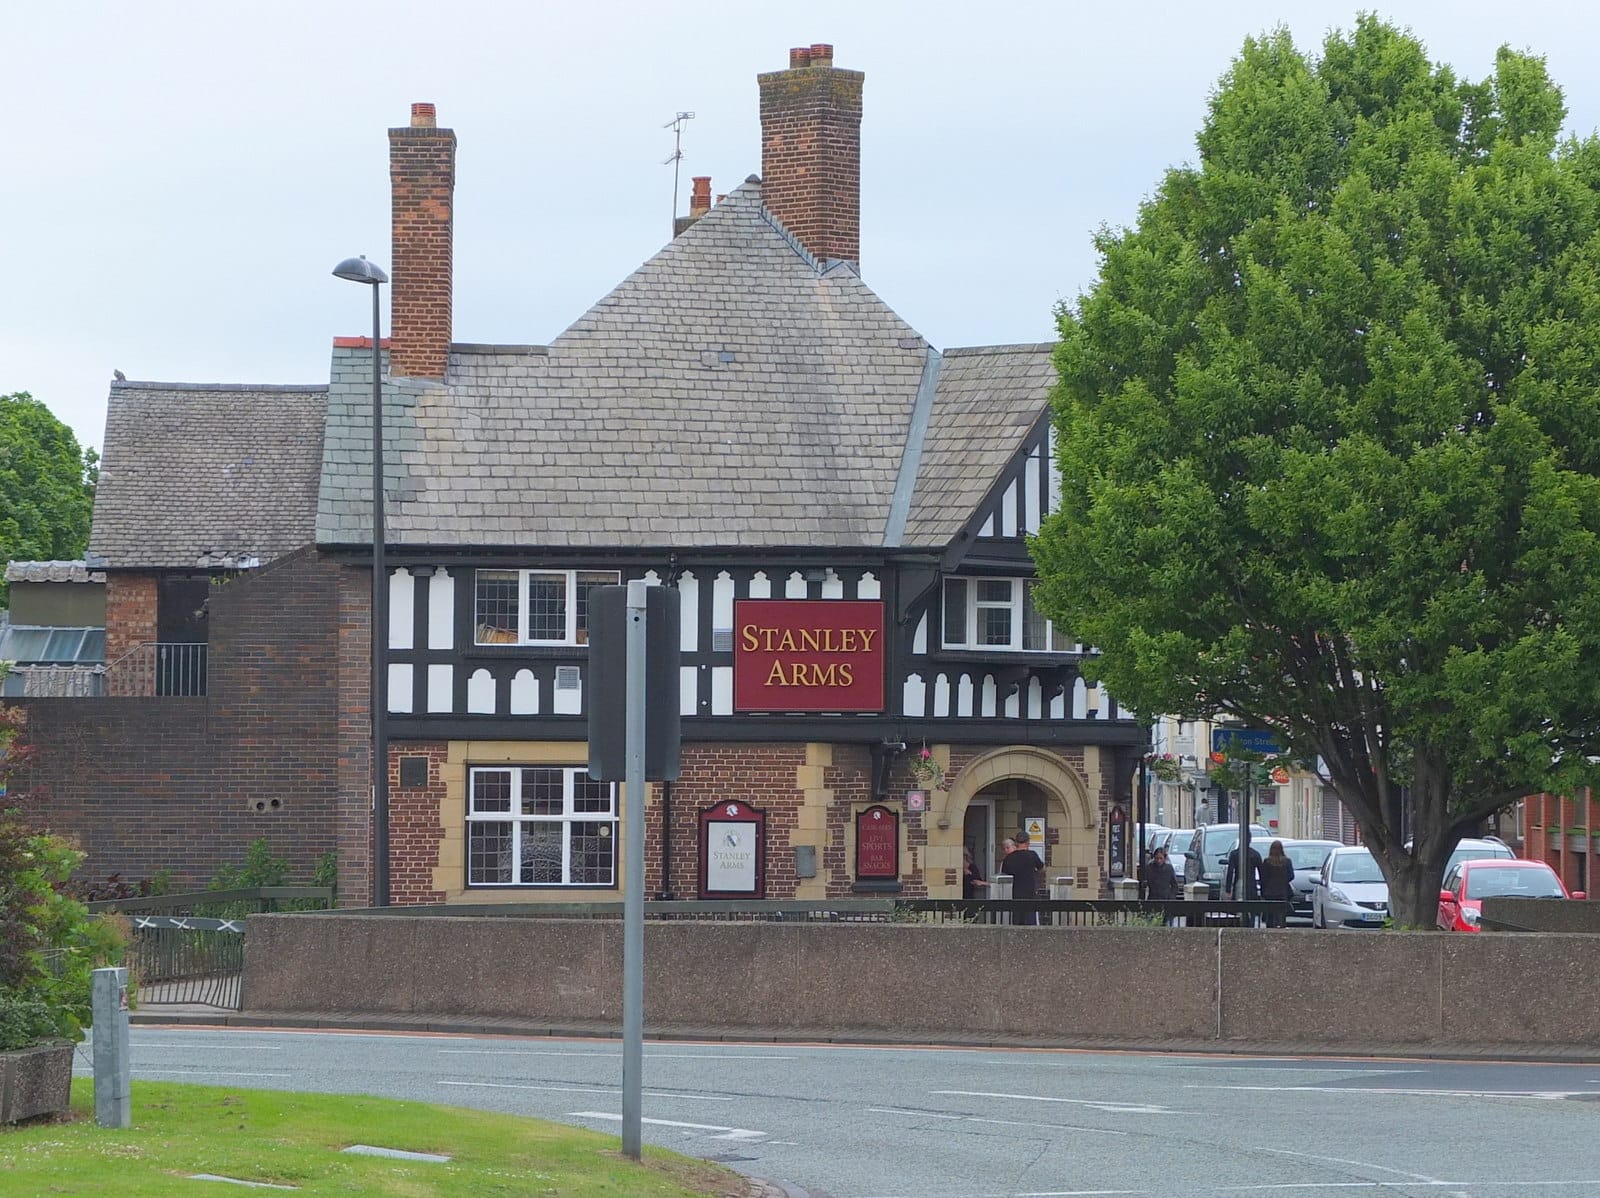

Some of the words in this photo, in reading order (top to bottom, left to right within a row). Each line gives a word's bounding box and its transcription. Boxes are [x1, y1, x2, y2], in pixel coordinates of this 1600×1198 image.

[742, 624, 877, 652] STANLEY
[763, 659, 853, 687] ARMS
[862, 842, 892, 851] SPORTS
[713, 851, 751, 860] STANLEY
[720, 861, 745, 870] ARMS
[864, 862, 891, 870] SNACKS
